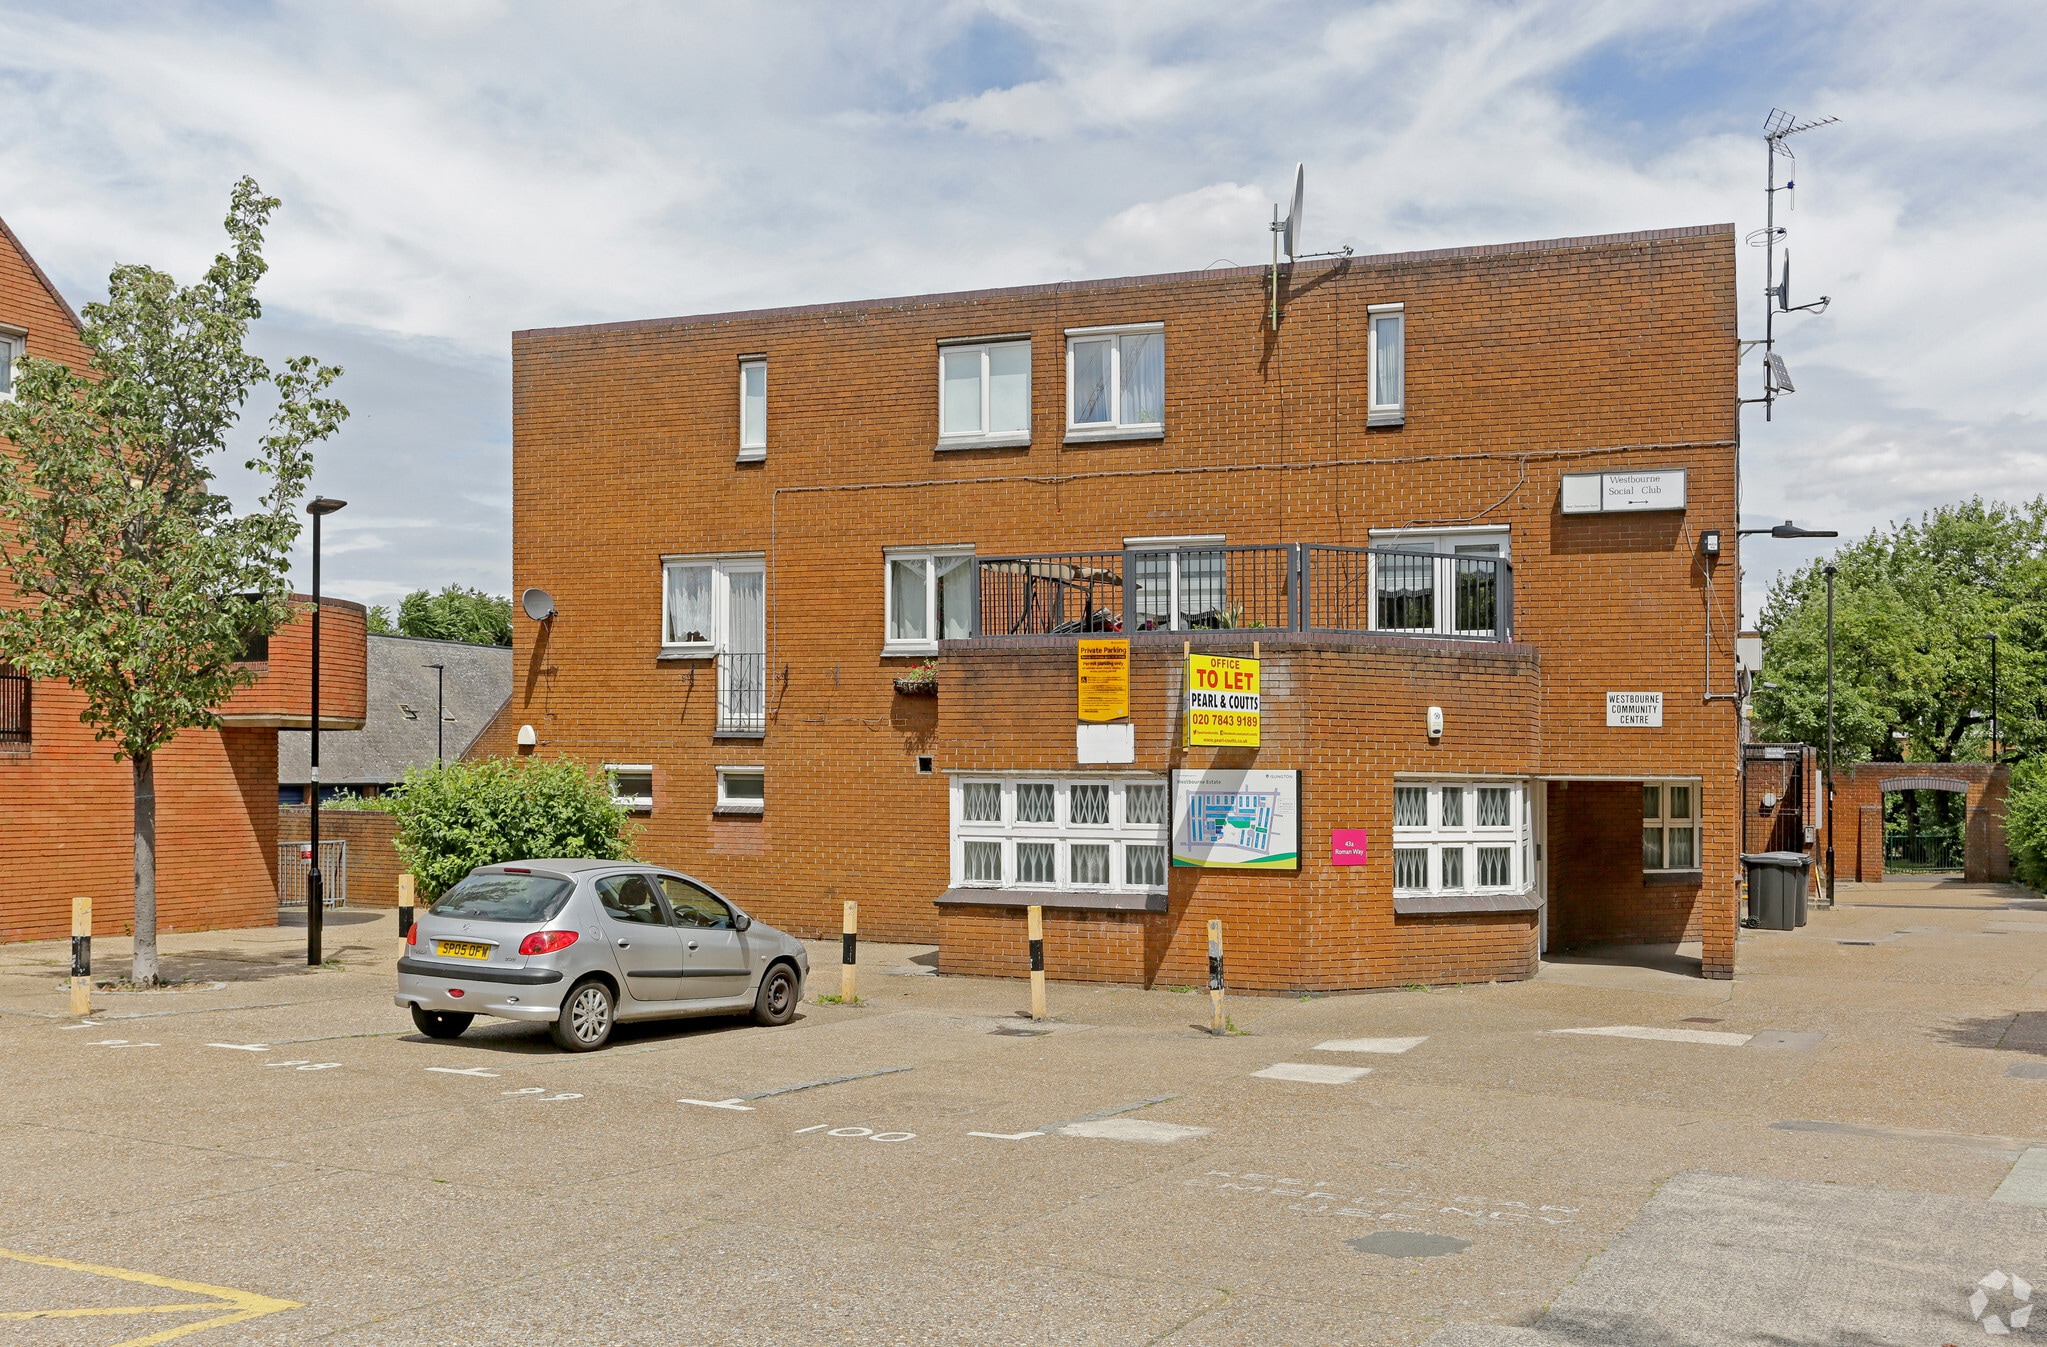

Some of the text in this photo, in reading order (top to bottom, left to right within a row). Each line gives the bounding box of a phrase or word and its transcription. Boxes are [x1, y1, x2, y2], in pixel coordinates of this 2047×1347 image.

[1610, 476, 1660, 484] Westbourne
[1608, 486, 1662, 496] Social Club
[1210, 658, 1240, 670] OFFICE
[1196, 668, 1254, 690] TO LET
[1192, 692, 1258, 710] PEARL & COUTTS
[1608, 694, 1660, 704] WESTBOURNE
[1612, 704, 1658, 714] COMMUNITY
[1192, 714, 1258, 726] 020 7843 9189
[1620, 714, 1648, 724] CENTRE
[442, 944, 488, 956] SP05 OFW
[264, 1060, 342, 1070] 98
[500, 1088, 584, 1100] 99
[794, 1124, 916, 1142] 100
